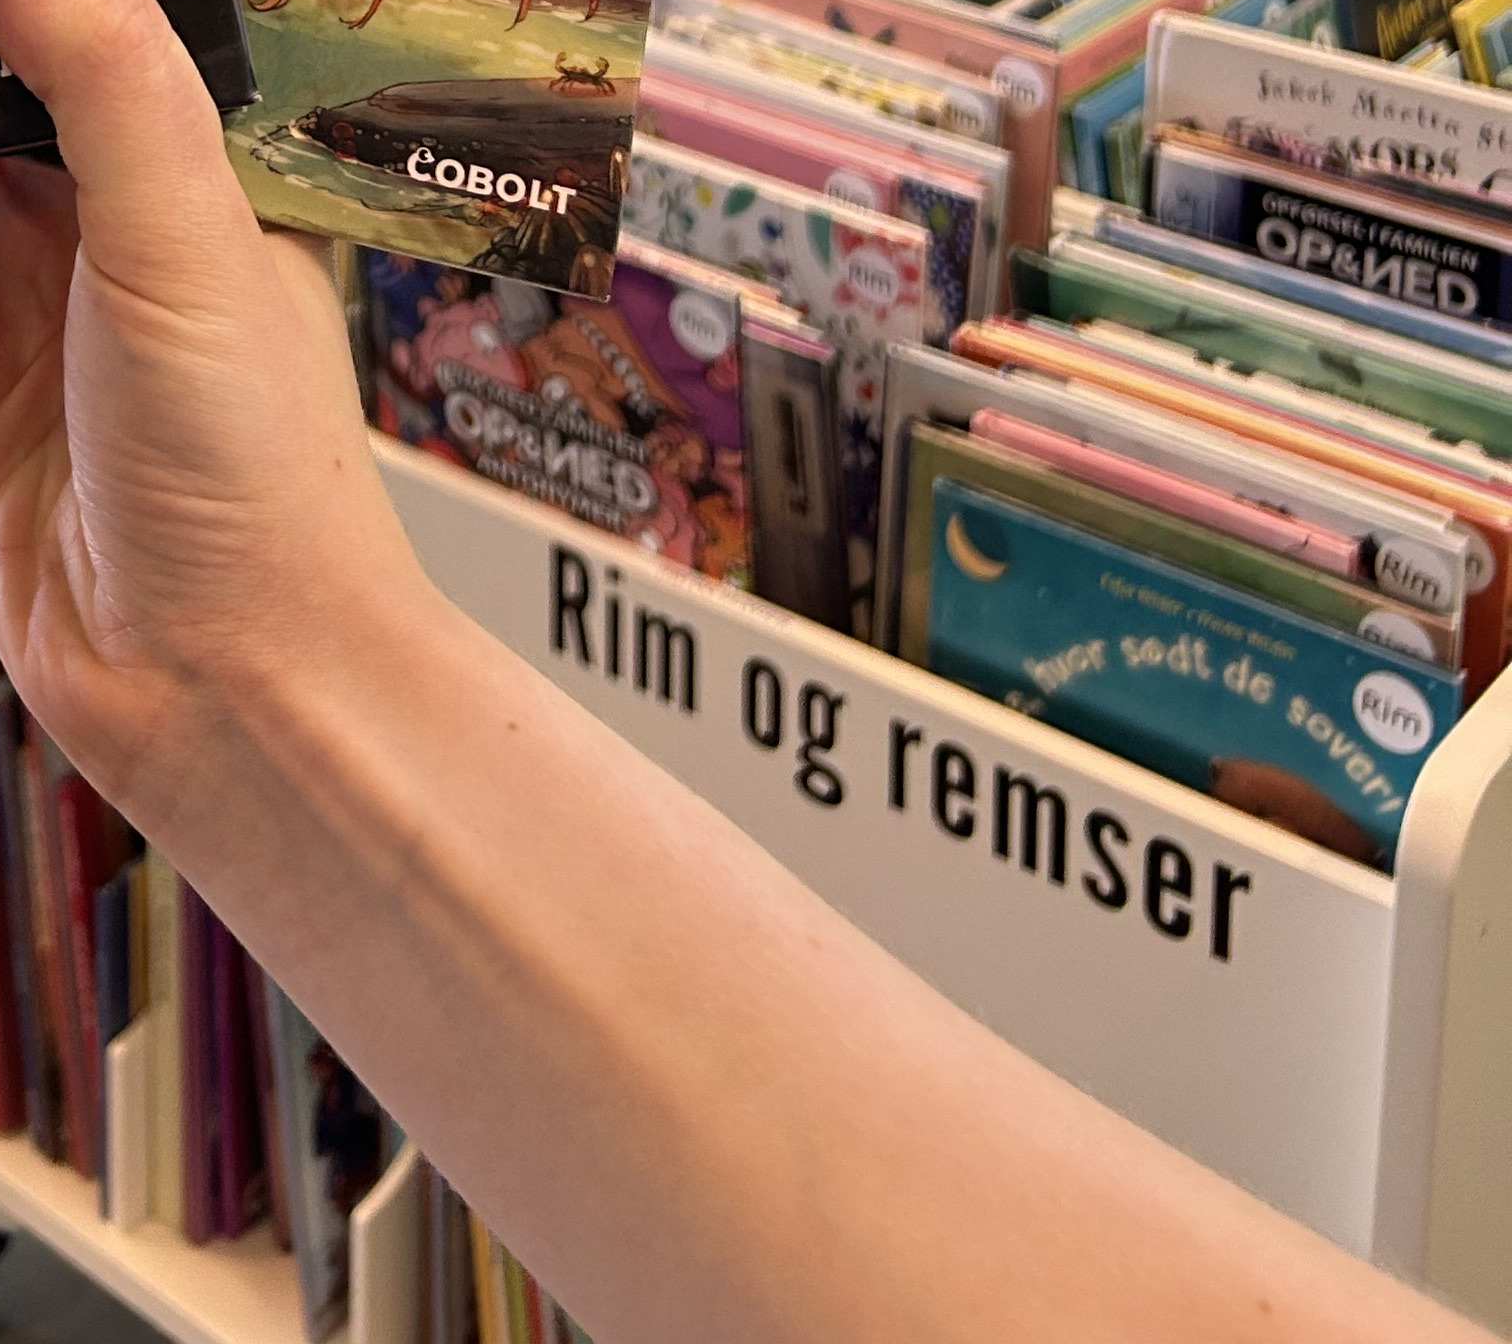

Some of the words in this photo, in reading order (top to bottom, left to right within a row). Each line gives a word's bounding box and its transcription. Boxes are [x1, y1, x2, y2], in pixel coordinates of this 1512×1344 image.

[407, 147, 577, 215] COBOLT
[1381, 548, 1441, 603] Rim
[1360, 688, 1424, 737] Rim
[548, 543, 698, 714] Rim
[741, 655, 846, 807] og
[889, 716, 1252, 962] remser
